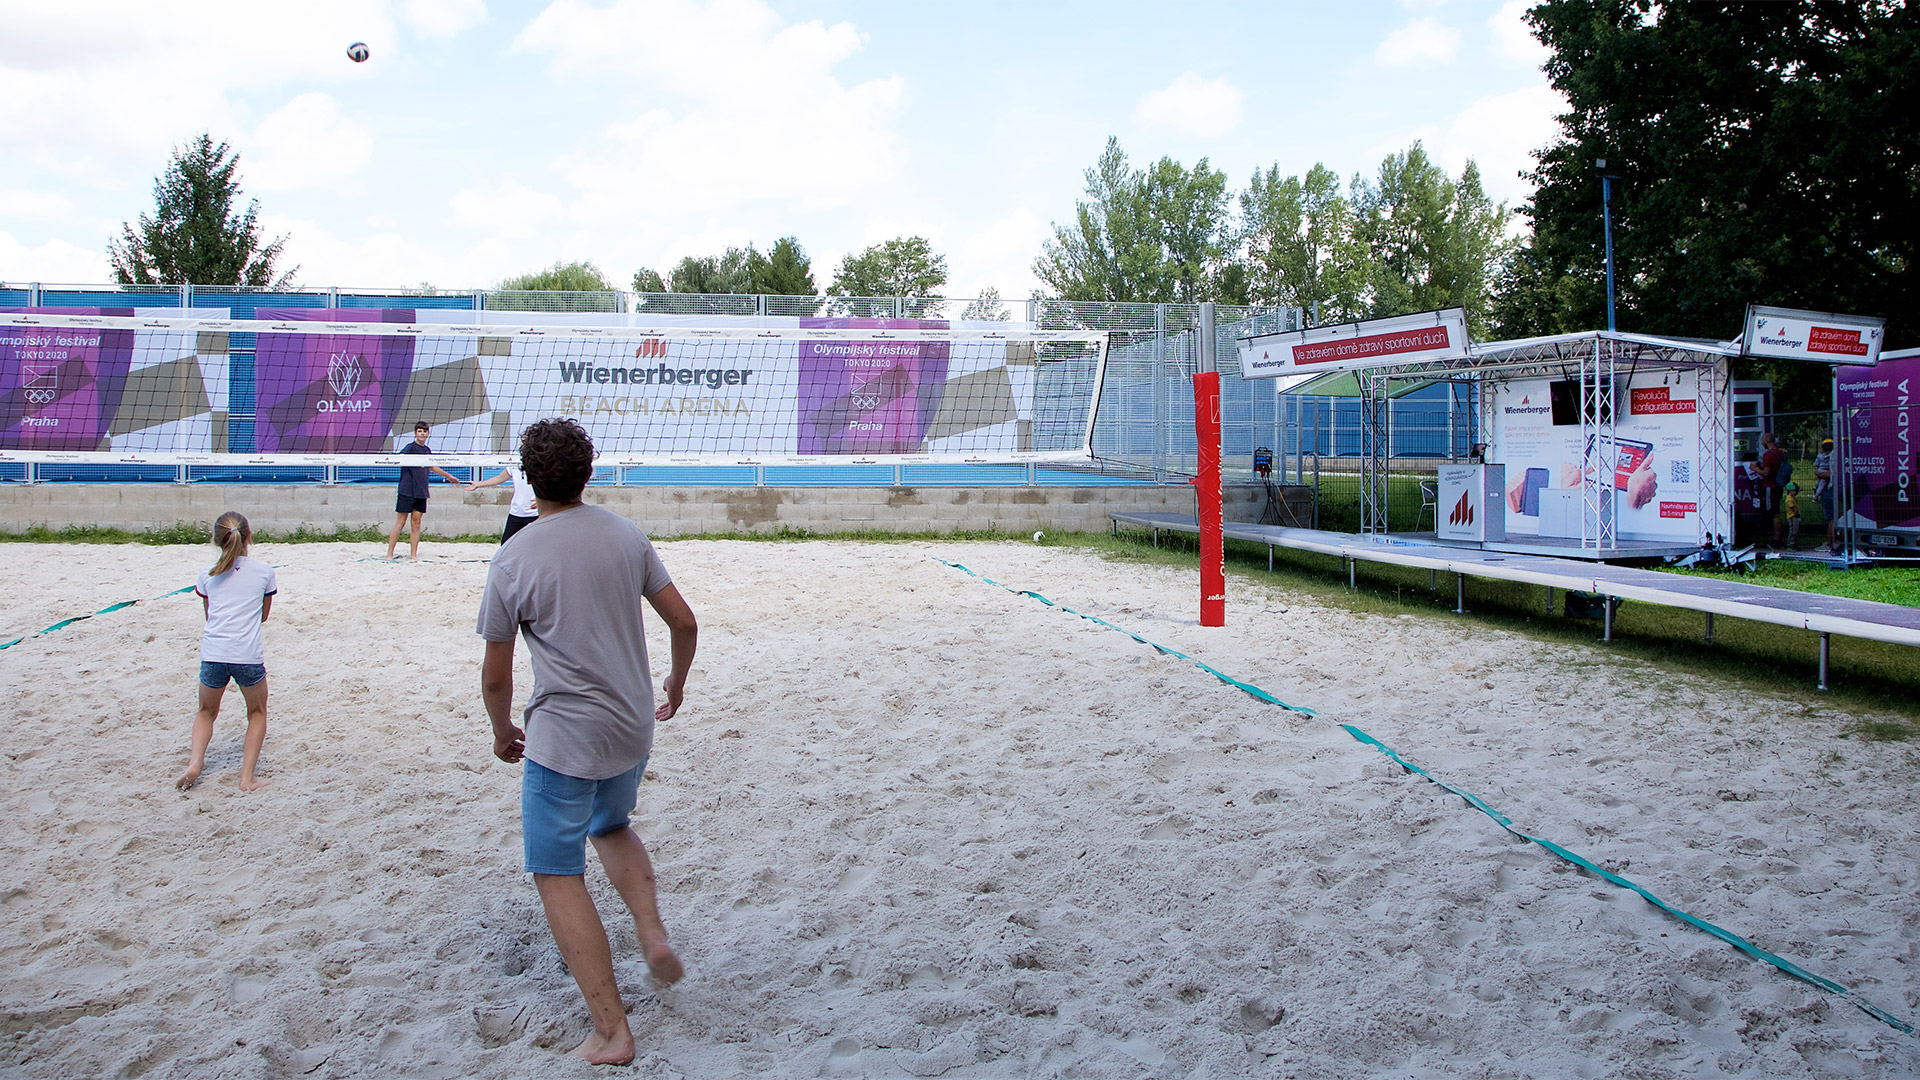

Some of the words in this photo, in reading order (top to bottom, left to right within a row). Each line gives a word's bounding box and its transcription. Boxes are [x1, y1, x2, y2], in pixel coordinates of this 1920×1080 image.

[0, 335, 51, 348] mpijský
[55, 335, 101, 346] festival
[1820, 331, 1842, 340] zdravém
[1295, 350, 1306, 361] Ve
[1306, 346, 1335, 360] zdravém
[1336, 343, 1358, 355] domě
[1359, 340, 1384, 353] zdravý
[1385, 333, 1422, 351] sportovní
[1423, 332, 1446, 345] duch
[1760, 336, 1802, 348] Wienerberger
[1809, 342, 1827, 351] zdravý
[1828, 342, 1852, 353] sportovní
[15, 350, 44, 359] TOKYO
[46, 351, 68, 359] 2020
[814, 343, 876, 357] Olympijský
[879, 345, 920, 355] festival
[844, 359, 870, 367] TOKYO
[871, 359, 891, 367] 2020
[1252, 359, 1286, 369] Wienerberger
[559, 361, 752, 390] Wienerberger
[1839, 382, 1868, 391] Olympijský
[1869, 379, 1889, 389] festival
[1633, 389, 1669, 400] Revoluční
[316, 399, 372, 413] OLYMP
[560, 397, 649, 417] BEACH
[658, 398, 751, 418] ARENA
[1504, 406, 1551, 414] Wienerberger
[1633, 401, 1675, 413] konfigurátor
[21, 415, 59, 427] Praha
[849, 420, 883, 431] Praha
[1855, 436, 1872, 444] Praha
[1897, 378, 1909, 502] POKLADNA
